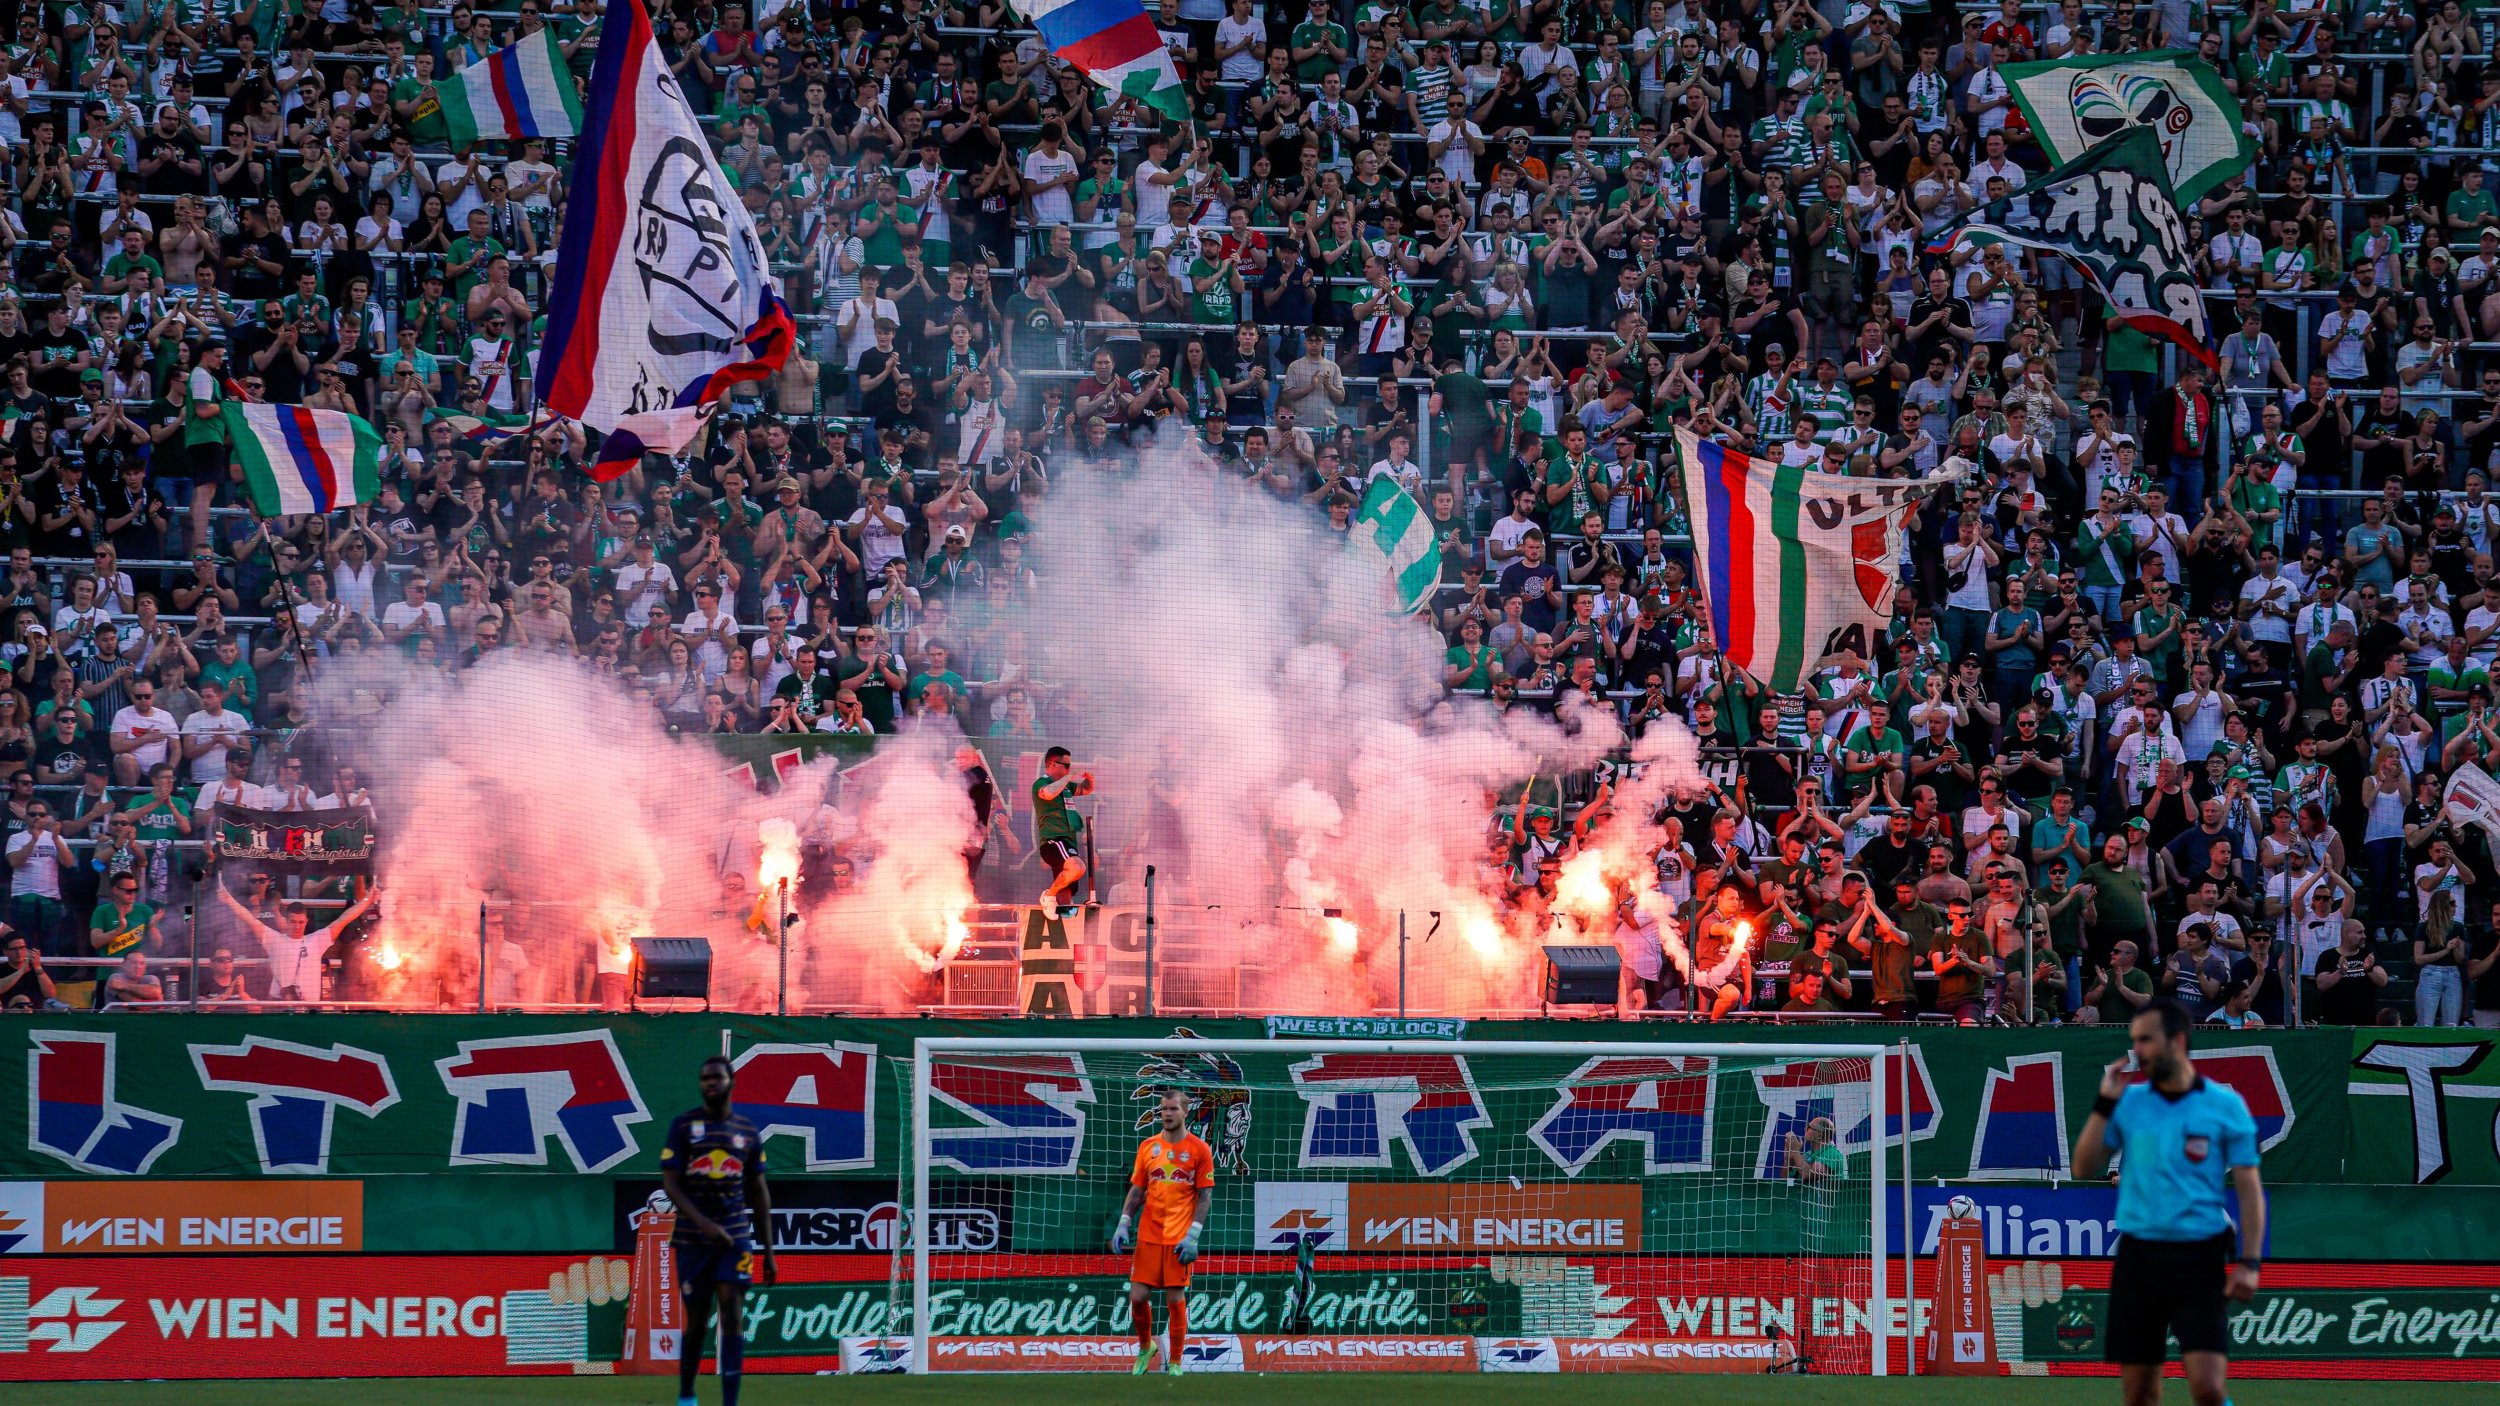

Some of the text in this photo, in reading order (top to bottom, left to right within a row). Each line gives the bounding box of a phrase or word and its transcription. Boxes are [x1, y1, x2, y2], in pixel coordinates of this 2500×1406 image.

[1204, 294, 1231, 305] RAPID
[1275, 1016, 1455, 1037] WEST BLOCK
[62, 1216, 343, 1246] WIEN ENERGIE
[1365, 1217, 1624, 1246] WIEN ENERGIE
[1962, 1244, 1973, 1328] WIEN ENERGIE
[148, 1296, 508, 1339] WIEN ENERG
[781, 1290, 914, 1342] voller
[928, 1289, 1098, 1336] Energie
[1656, 1296, 1931, 1337] WIEN ENER
[2228, 1297, 2500, 1357] oller Energi
[937, 1341, 1017, 1356] WIEN
[1255, 1340, 1468, 1357] WIEN ENERGIE
[1570, 1342, 1650, 1357] WIEN
